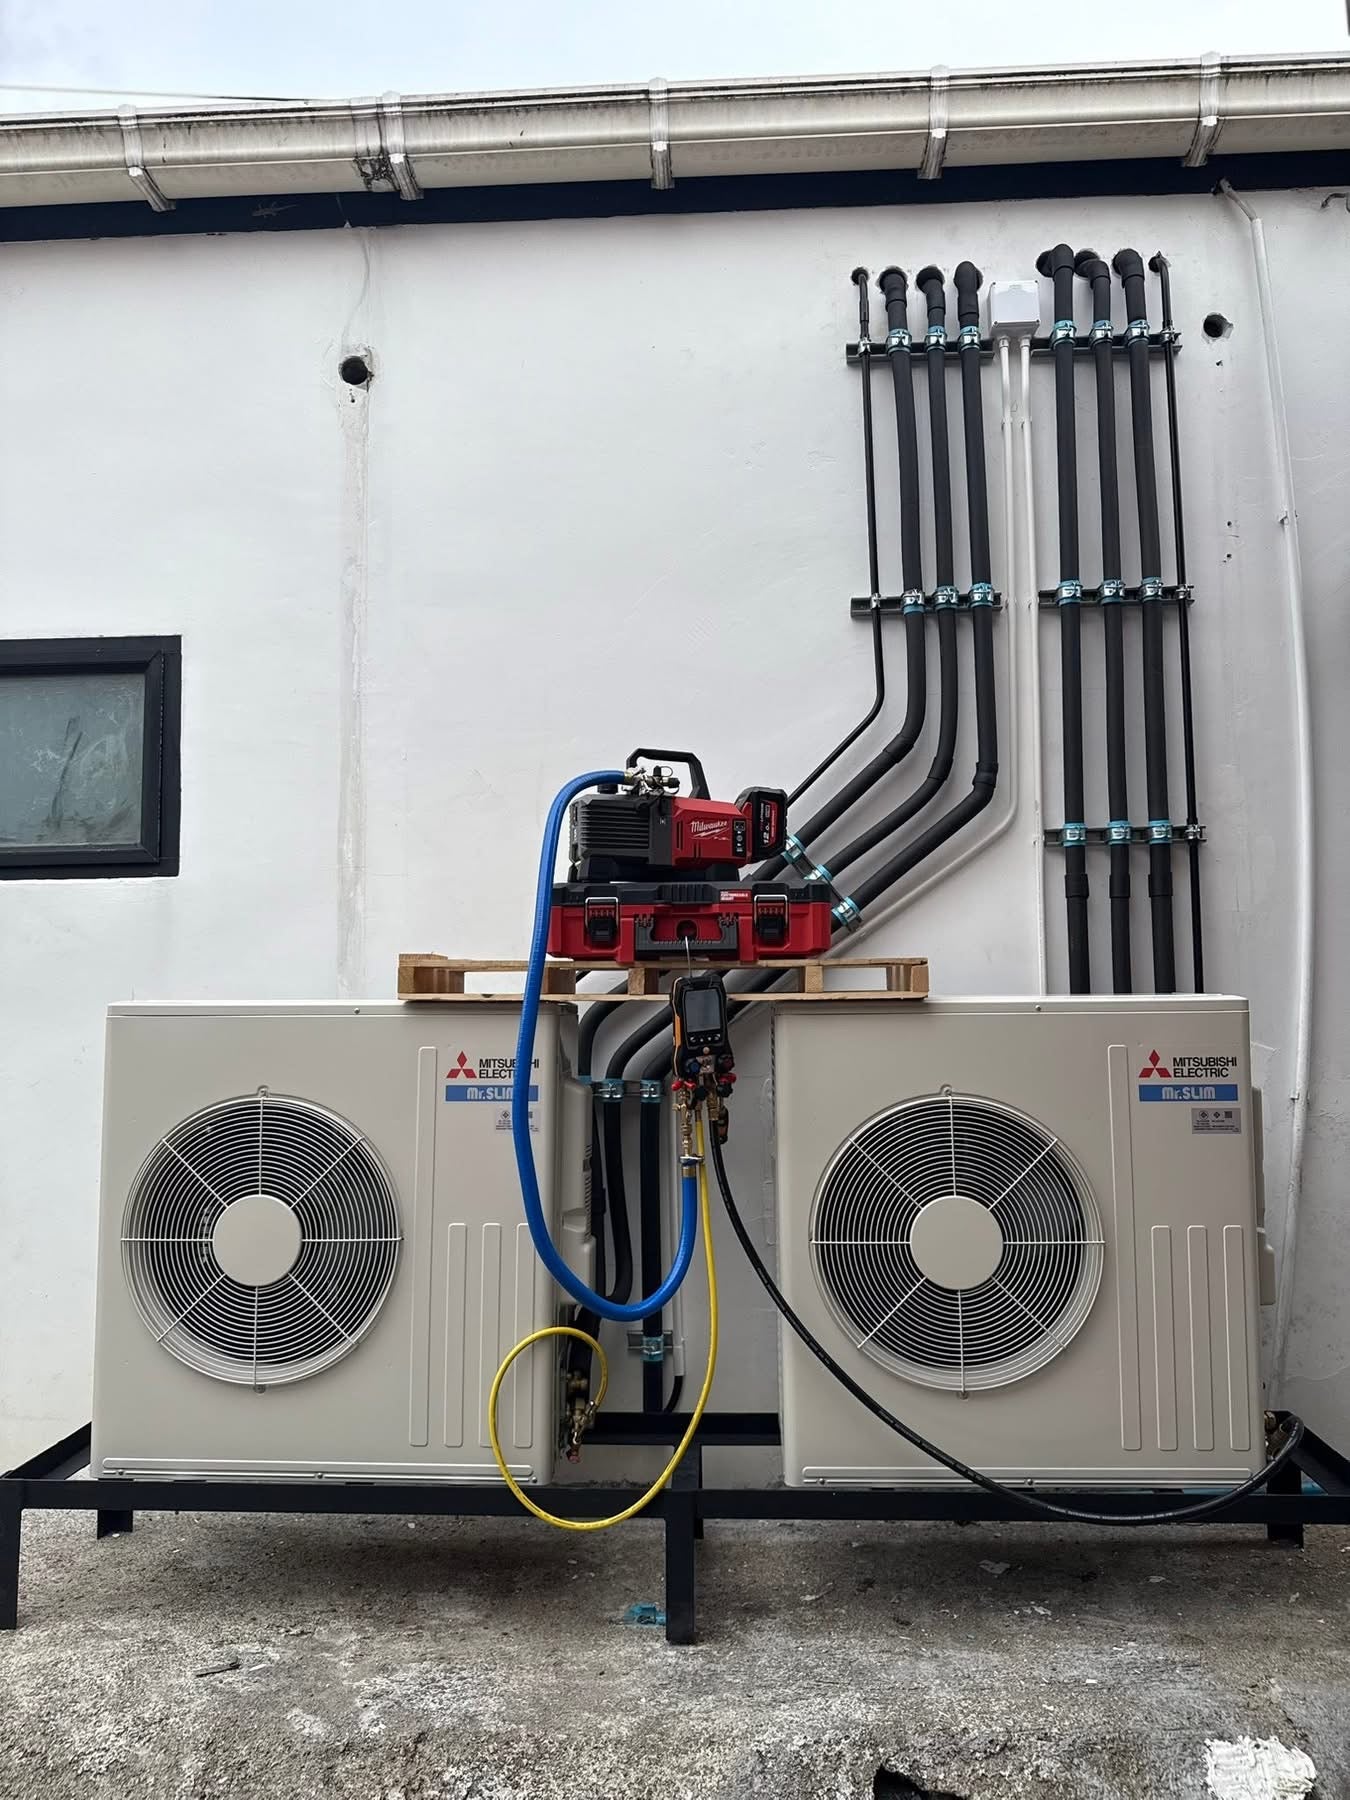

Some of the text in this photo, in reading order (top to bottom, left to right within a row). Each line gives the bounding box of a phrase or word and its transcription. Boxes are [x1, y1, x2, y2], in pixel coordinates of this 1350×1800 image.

[690, 820, 728, 833] Milwaukee
[479, 1058, 540, 1069] MITSUHI
[1173, 1057, 1237, 1067] MITSUBISHI
[479, 1069, 515, 1079] ELECT
[1173, 1068, 1229, 1078] ELECTRIC
[1161, 1086, 1216, 1100] Mr.SLIM
